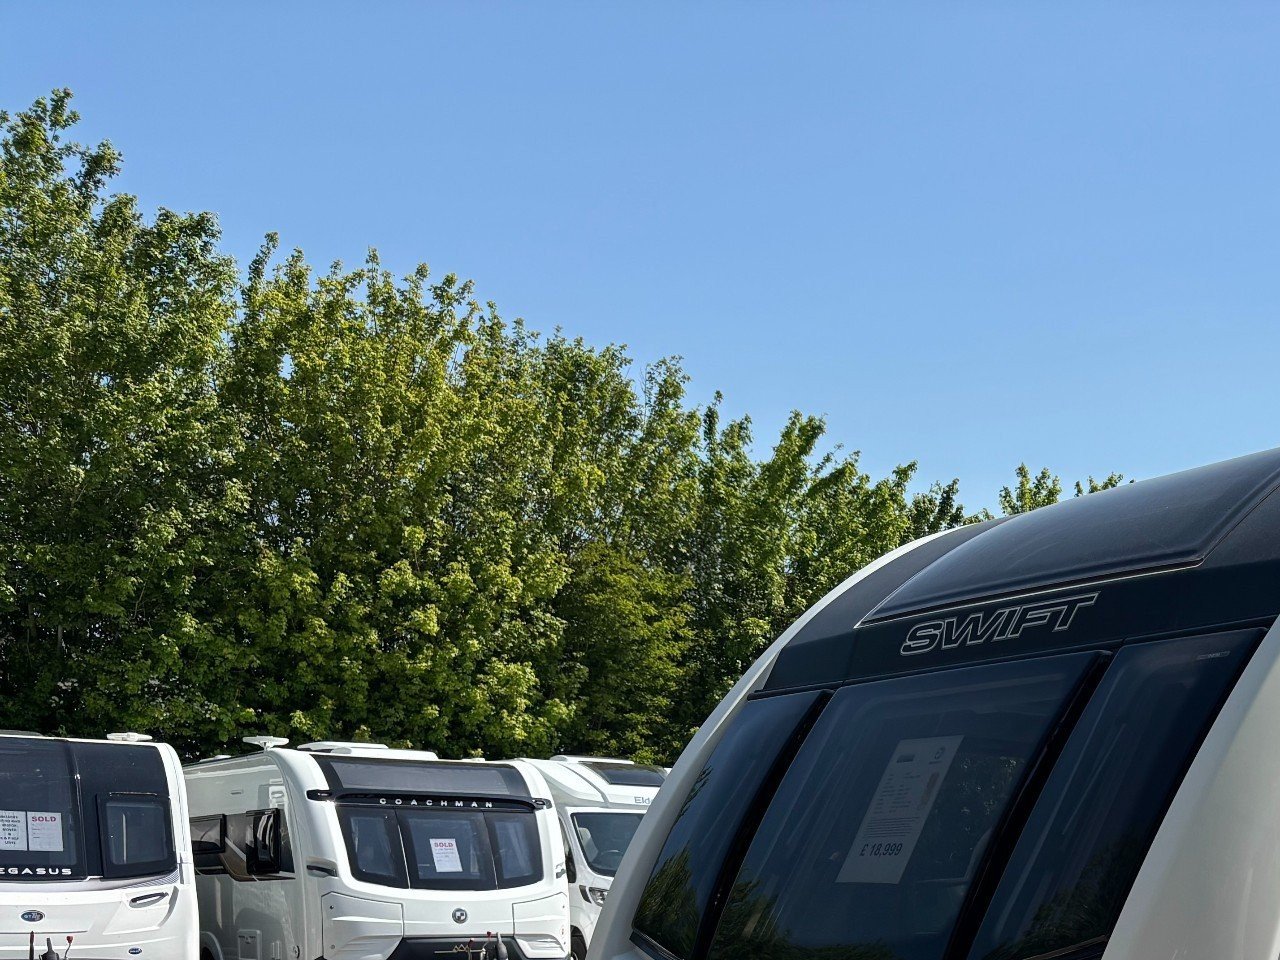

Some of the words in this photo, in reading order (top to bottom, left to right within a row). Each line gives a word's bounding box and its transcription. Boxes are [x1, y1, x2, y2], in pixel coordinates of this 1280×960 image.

[900, 591, 1101, 656] SWIFT
[379, 798, 493, 808] COACHMAN
[634, 796, 651, 805] Eld
[870, 843, 903, 857] 18,999
[0, 867, 72, 875] EGASUS
